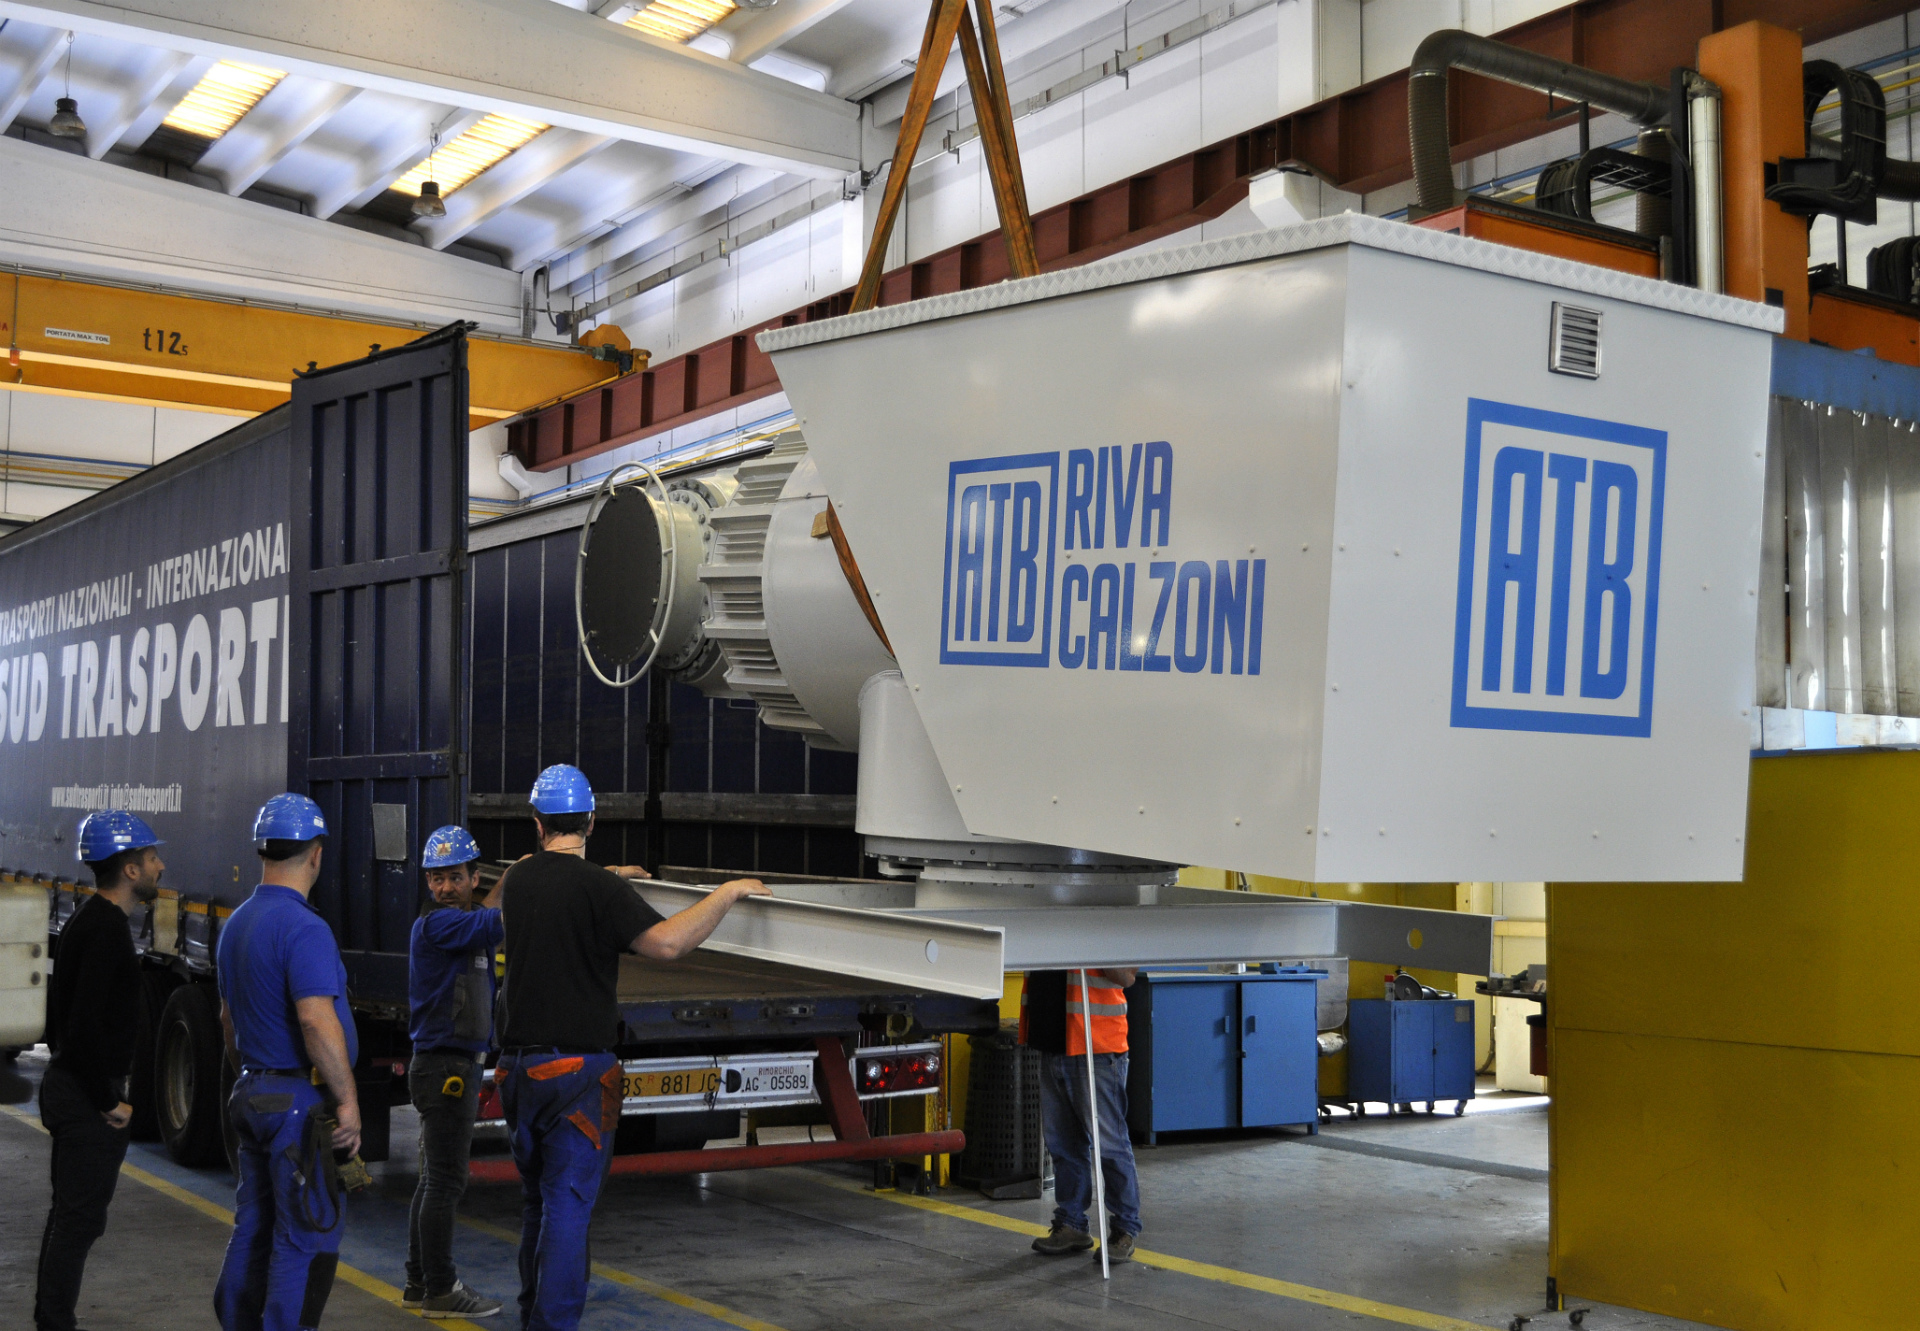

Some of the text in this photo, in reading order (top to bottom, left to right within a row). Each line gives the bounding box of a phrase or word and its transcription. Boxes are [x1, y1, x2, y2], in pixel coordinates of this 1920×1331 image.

[46, 329, 76, 339] PORTATA
[1064, 441, 1173, 550] RIVA
[0, 596, 55, 646] TRASPORTI
[57, 572, 133, 632] NAZIONALI
[147, 520, 290, 609] INTERNAZIONA
[954, 480, 1042, 643] ATB
[1481, 446, 1638, 700] ATB
[0, 595, 289, 744] SUD TRASPORTI
[1058, 559, 1266, 676] CALZONI
[110, 783, 181, 814] info@sudtrasporti.it
[661, 1074, 690, 1094] 881
[745, 1075, 806, 1091] AG 05589
[758, 1065, 794, 1075] RIMORCHIO
